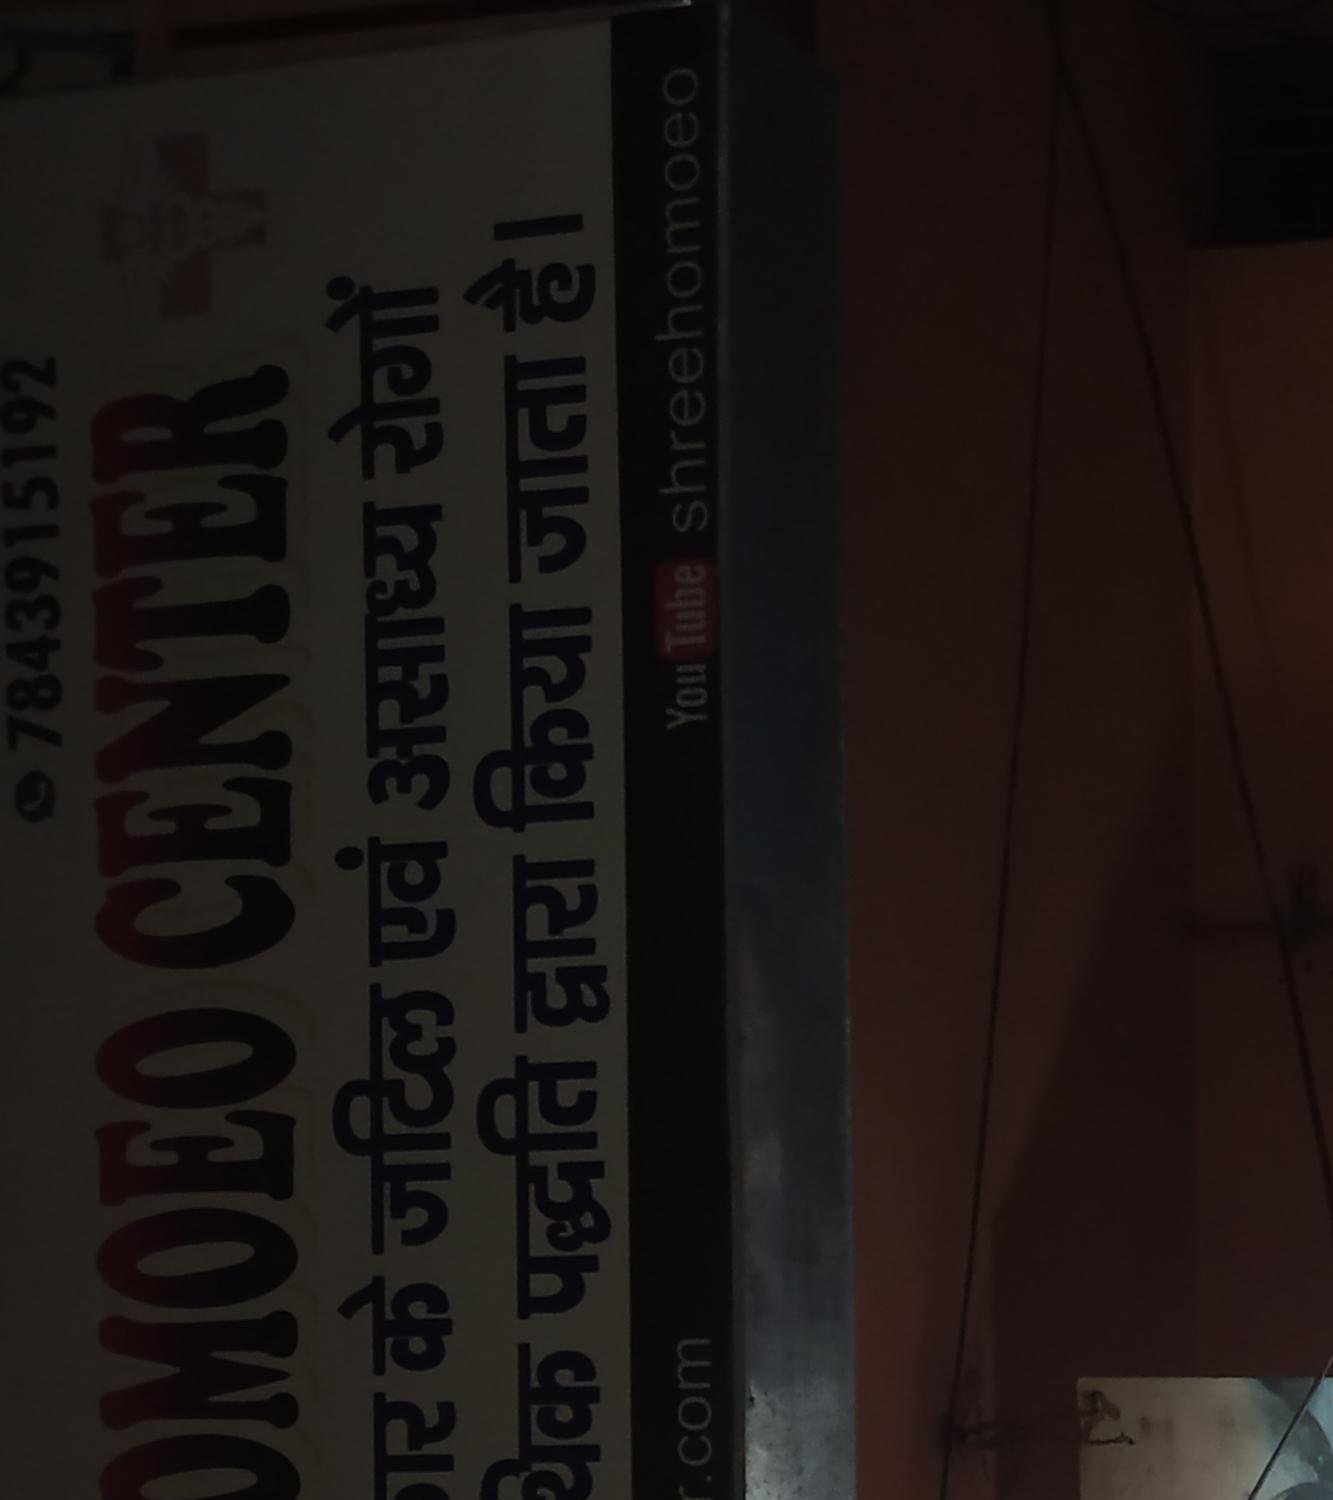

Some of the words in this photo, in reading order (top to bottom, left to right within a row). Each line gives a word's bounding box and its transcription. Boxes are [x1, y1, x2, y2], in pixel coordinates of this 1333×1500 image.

[323, 274, 446, 475] रोगों
[657, 66, 713, 533] shreehomoeo
[0, 355, 63, 752] 7843915192
[501, 355, 592, 583] जाता
[88, 364, 294, 969] CENTER
[361, 503, 450, 811] असाध्य
[472, 605, 597, 833] किया
[334, 837, 454, 966] एवं
[510, 854, 611, 1033] द्वारा
[332, 991, 456, 1255] जटिल
[337, 1277, 453, 1375] के
